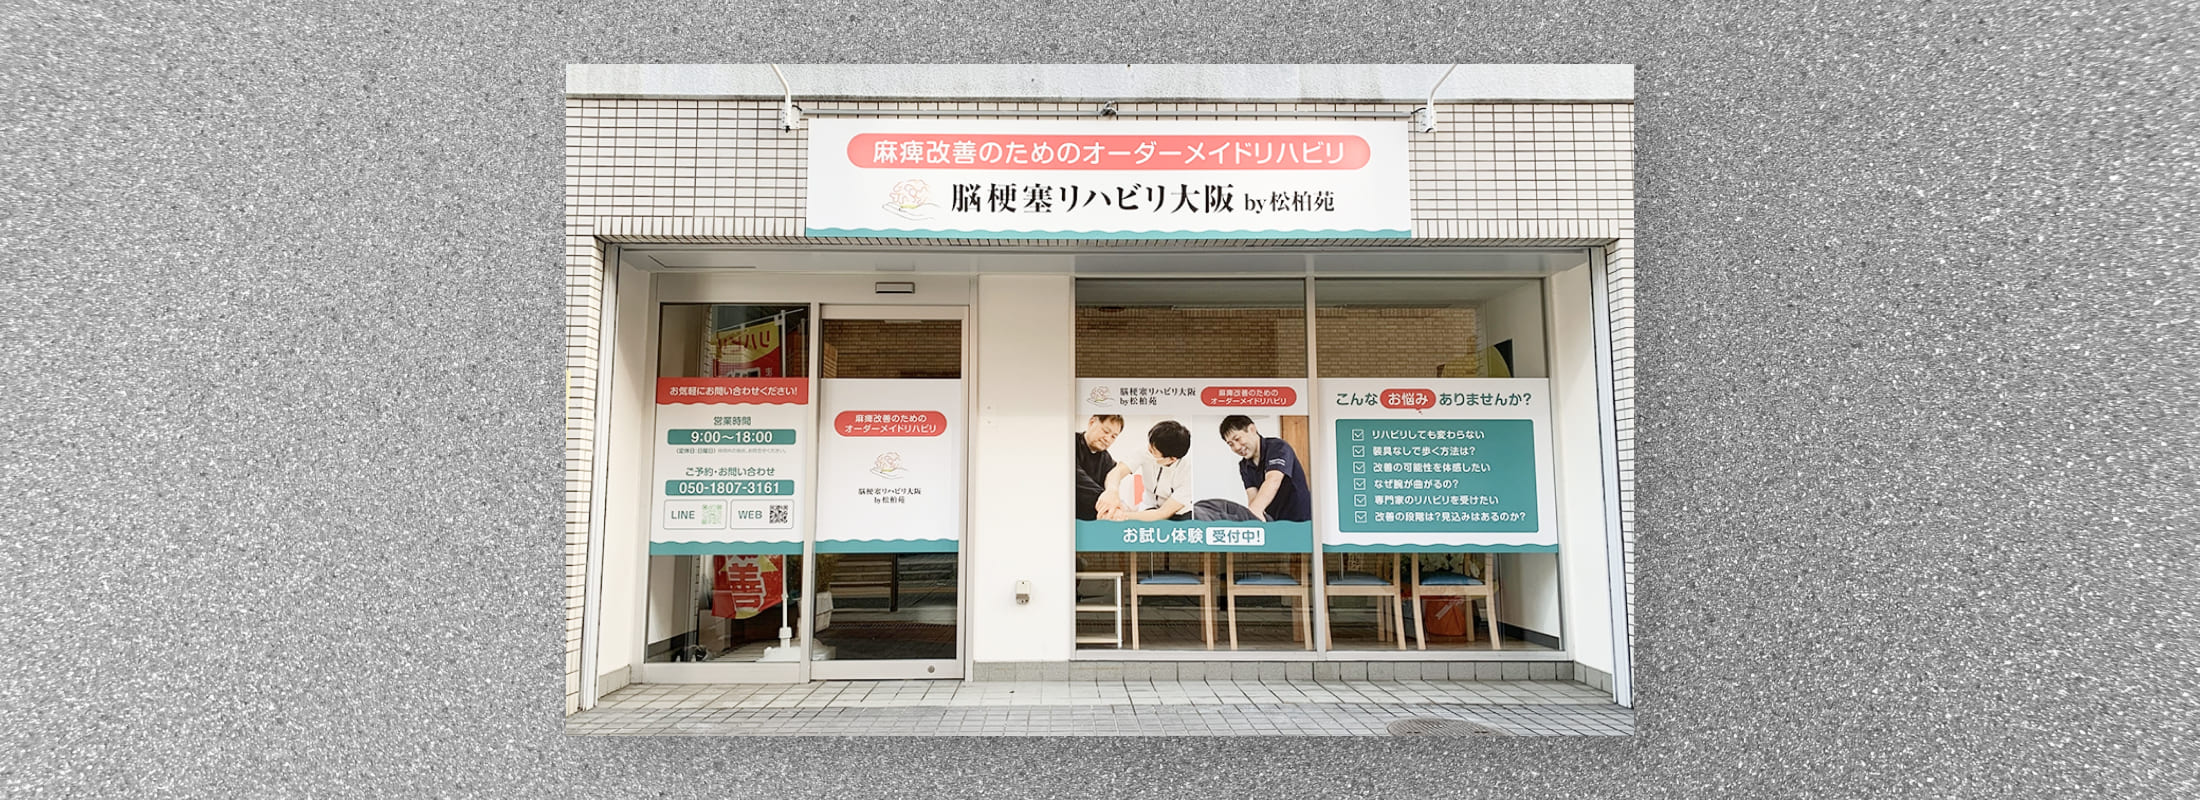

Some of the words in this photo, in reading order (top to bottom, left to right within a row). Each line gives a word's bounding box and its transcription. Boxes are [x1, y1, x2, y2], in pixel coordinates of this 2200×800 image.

[873, 140, 1345, 165] 麻痺改善のためのオーダーメイドリハビリ
[951, 183, 1234, 213] 脳梗塞リハビリ大阪
[1210, 397, 1287, 405] オーダーメイドリハビリ
[1336, 392, 1378, 406] こんな
[1388, 392, 1429, 406] お悩み
[1439, 392, 1532, 406] ありませんか?
[713, 416, 752, 426] 営業時間
[844, 424, 937, 433] オーダーメイドリハビリ
[1372, 430, 1485, 440] リハビリしても変わらない
[1373, 462, 1491, 473] 改善の可能性を体感したい
[679, 482, 779, 494] 050-1807-3161
[1374, 495, 1499, 505] 専門家のリハビリを受けたい
[671, 510, 696, 520] LINE
[738, 510, 763, 520] WEB
[1123, 527, 1204, 543] お試し体験
[1212, 529, 1261, 543] 受付中!
